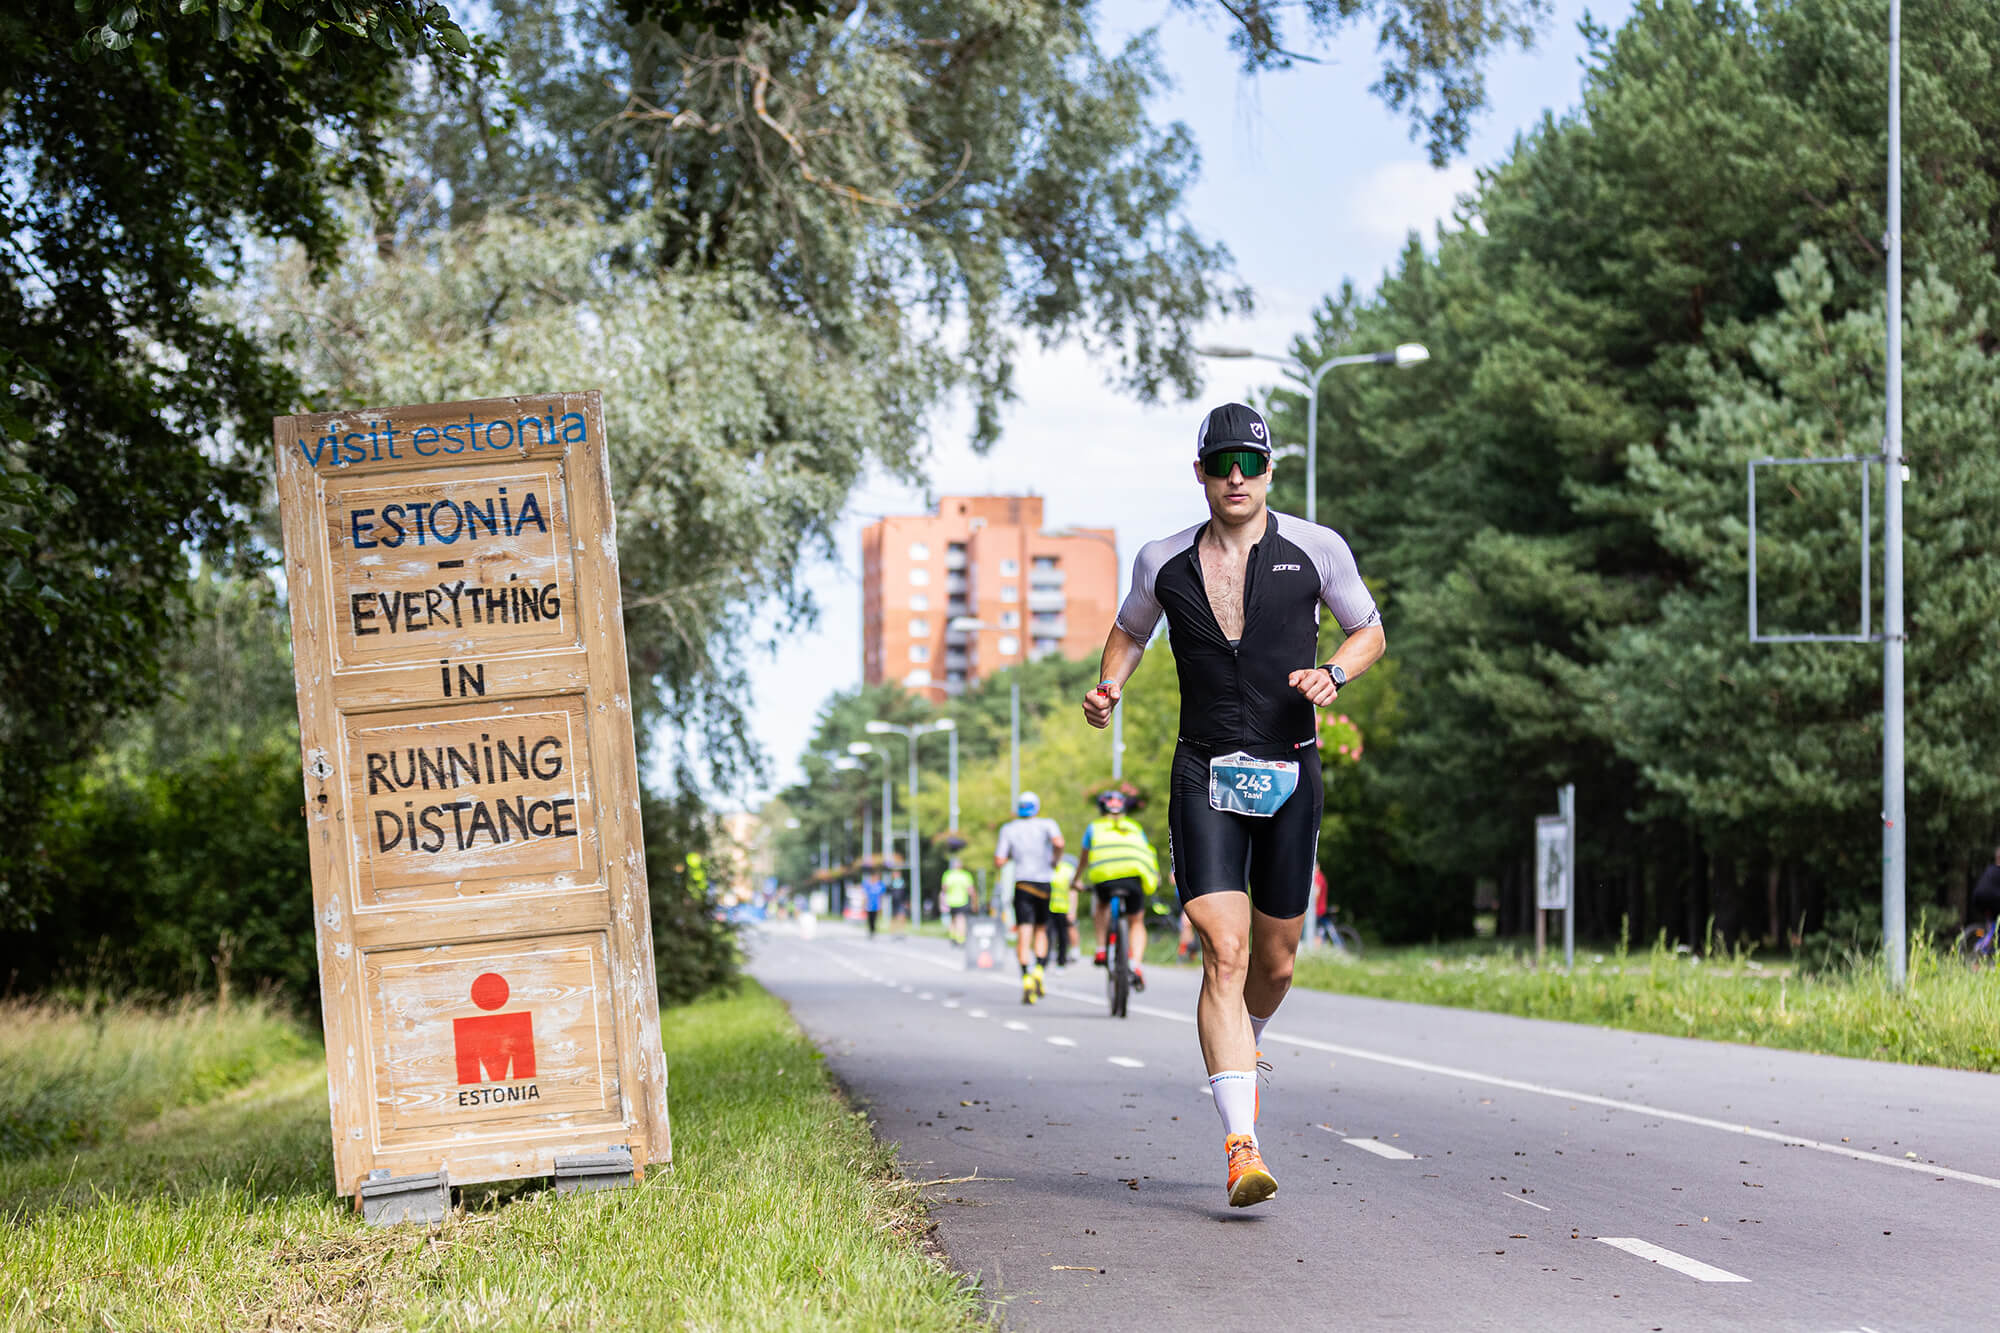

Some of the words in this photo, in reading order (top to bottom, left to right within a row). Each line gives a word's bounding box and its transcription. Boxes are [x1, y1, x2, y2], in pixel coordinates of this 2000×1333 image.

[299, 420, 403, 468] visit
[413, 405, 587, 456] estonia
[1235, 773, 1272, 792] 243
[458, 1085, 540, 1106] ESTONIA
